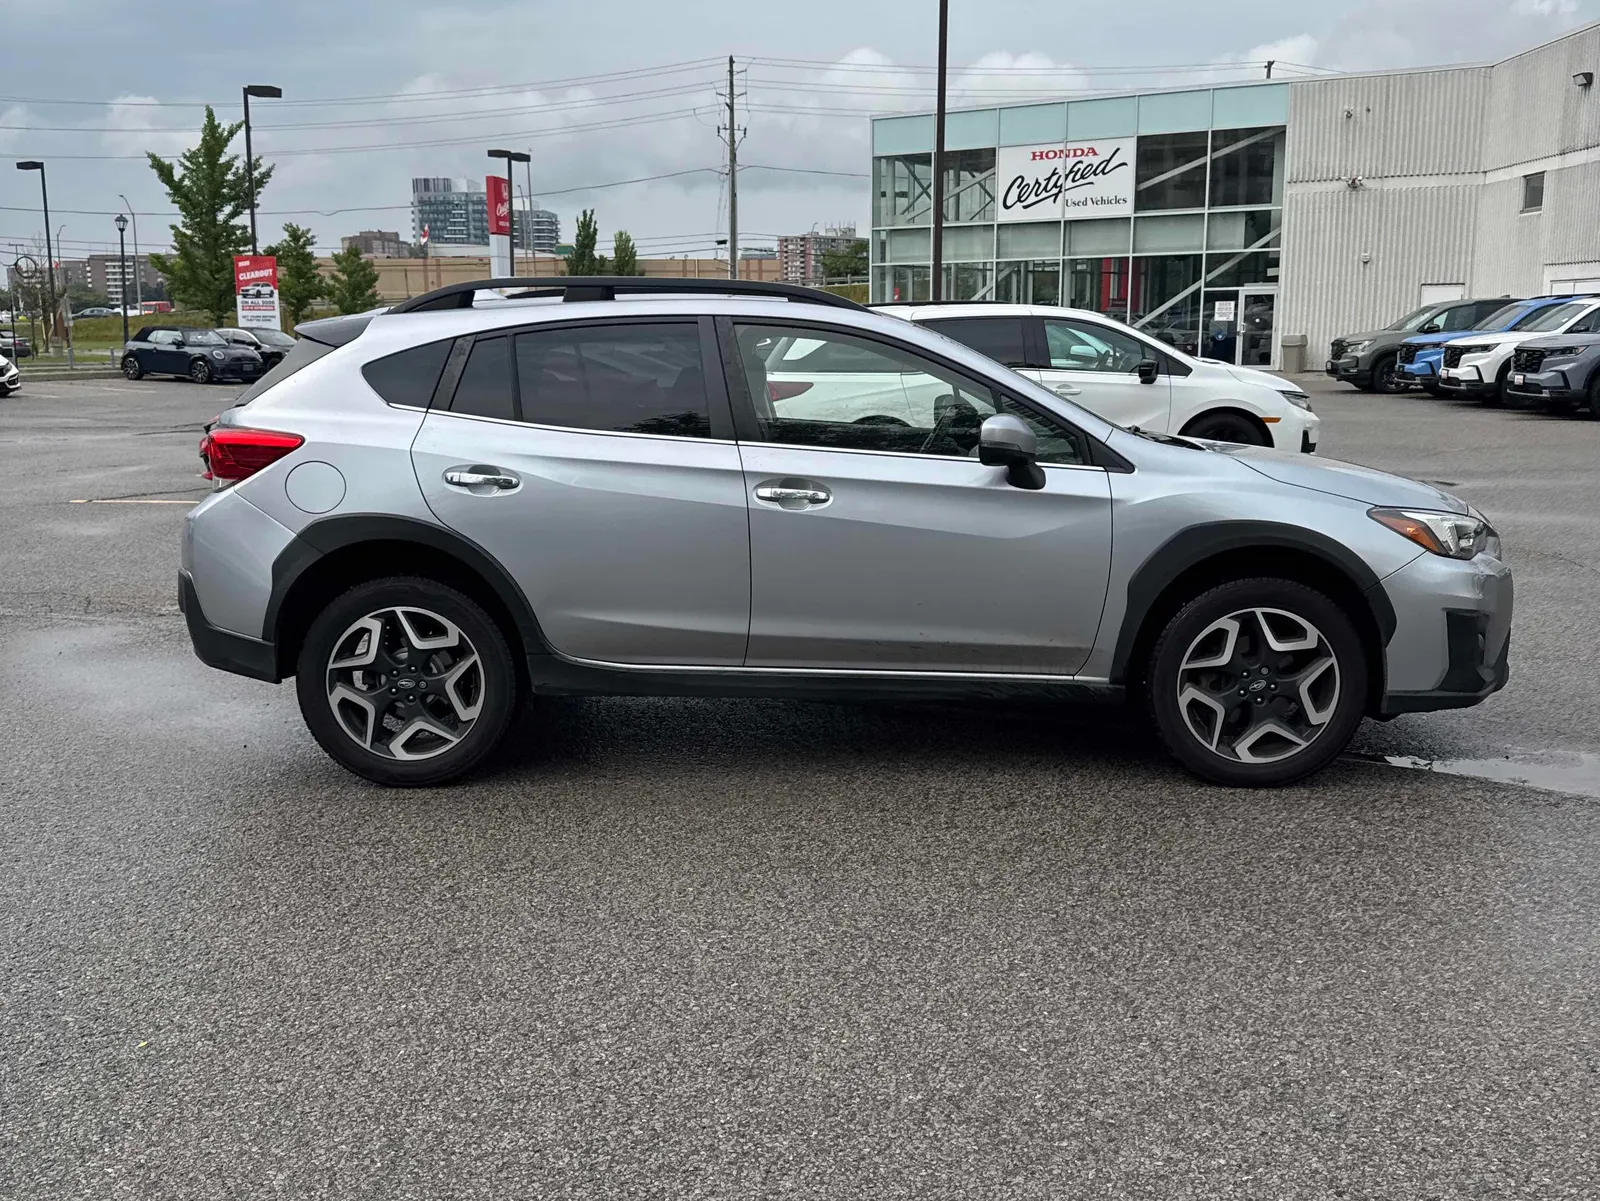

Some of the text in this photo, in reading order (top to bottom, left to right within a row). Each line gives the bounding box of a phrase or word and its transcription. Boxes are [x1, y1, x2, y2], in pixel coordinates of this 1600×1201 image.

[1031, 147, 1099, 161] HONDA
[1003, 148, 1128, 209] Certified
[1065, 195, 1127, 208] Used Vehicles
[239, 269, 273, 281] CLEAROUT
